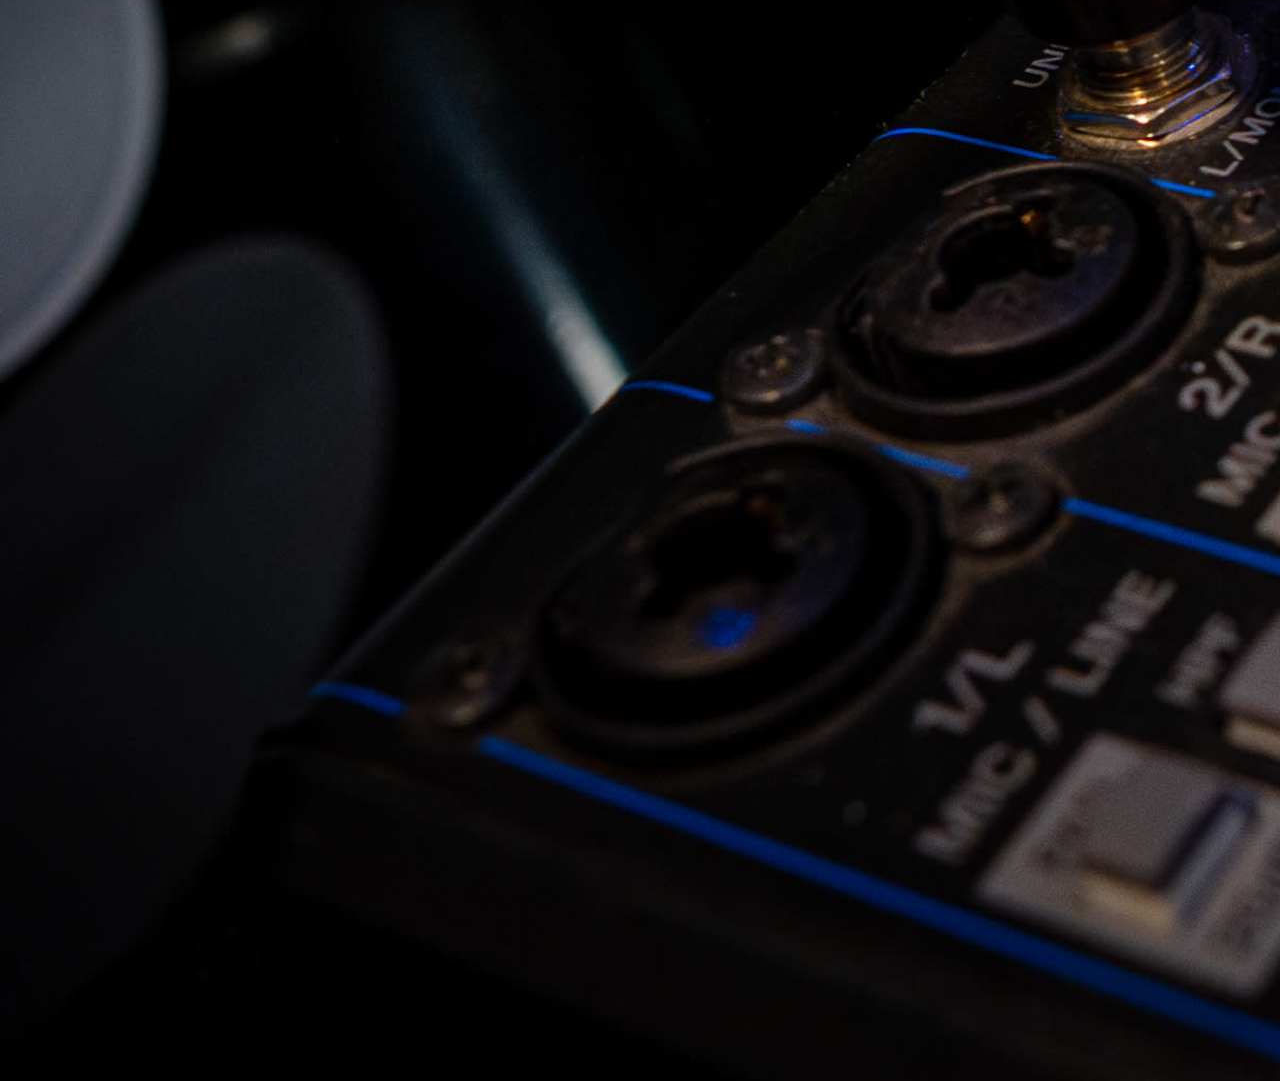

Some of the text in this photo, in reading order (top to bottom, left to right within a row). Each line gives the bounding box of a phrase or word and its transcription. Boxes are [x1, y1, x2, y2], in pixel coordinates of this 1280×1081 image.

[910, 737, 1040, 869] MIC
[1019, 692, 1065, 749] /
[1043, 566, 1180, 700] LINE
